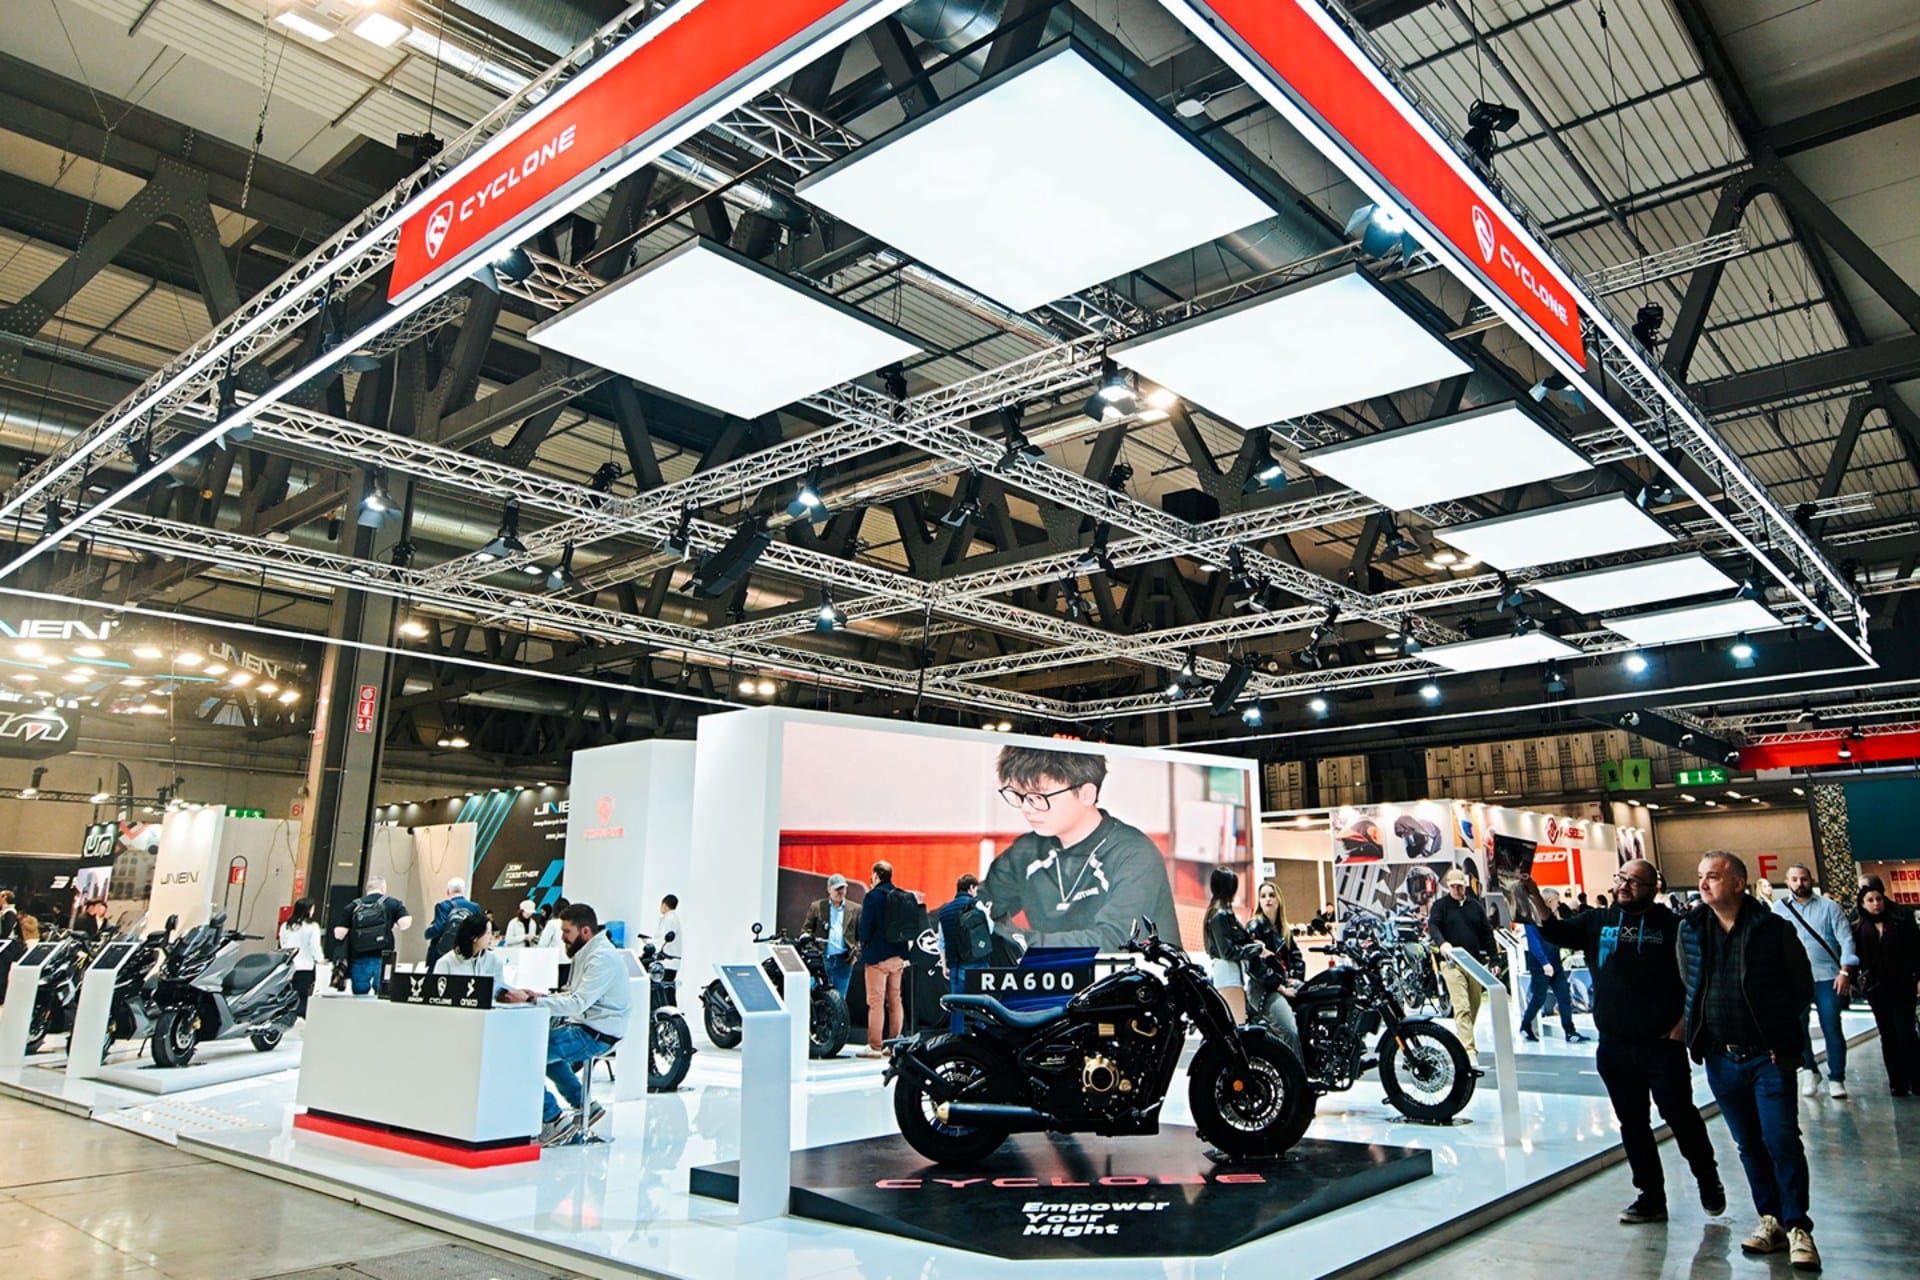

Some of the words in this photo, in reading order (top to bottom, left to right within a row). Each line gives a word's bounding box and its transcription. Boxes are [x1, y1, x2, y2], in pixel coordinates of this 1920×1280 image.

[459, 124, 577, 222] CYCLONE
[1500, 244, 1568, 326] CYCLONE
[1758, 855, 1778, 879] F
[981, 972, 1075, 991] RA600
[875, 1173, 1267, 1188] CYCLONE
[1021, 1201, 1170, 1214] Empower
[1025, 1213, 1104, 1223] Your
[1022, 1223, 1120, 1237] Might
